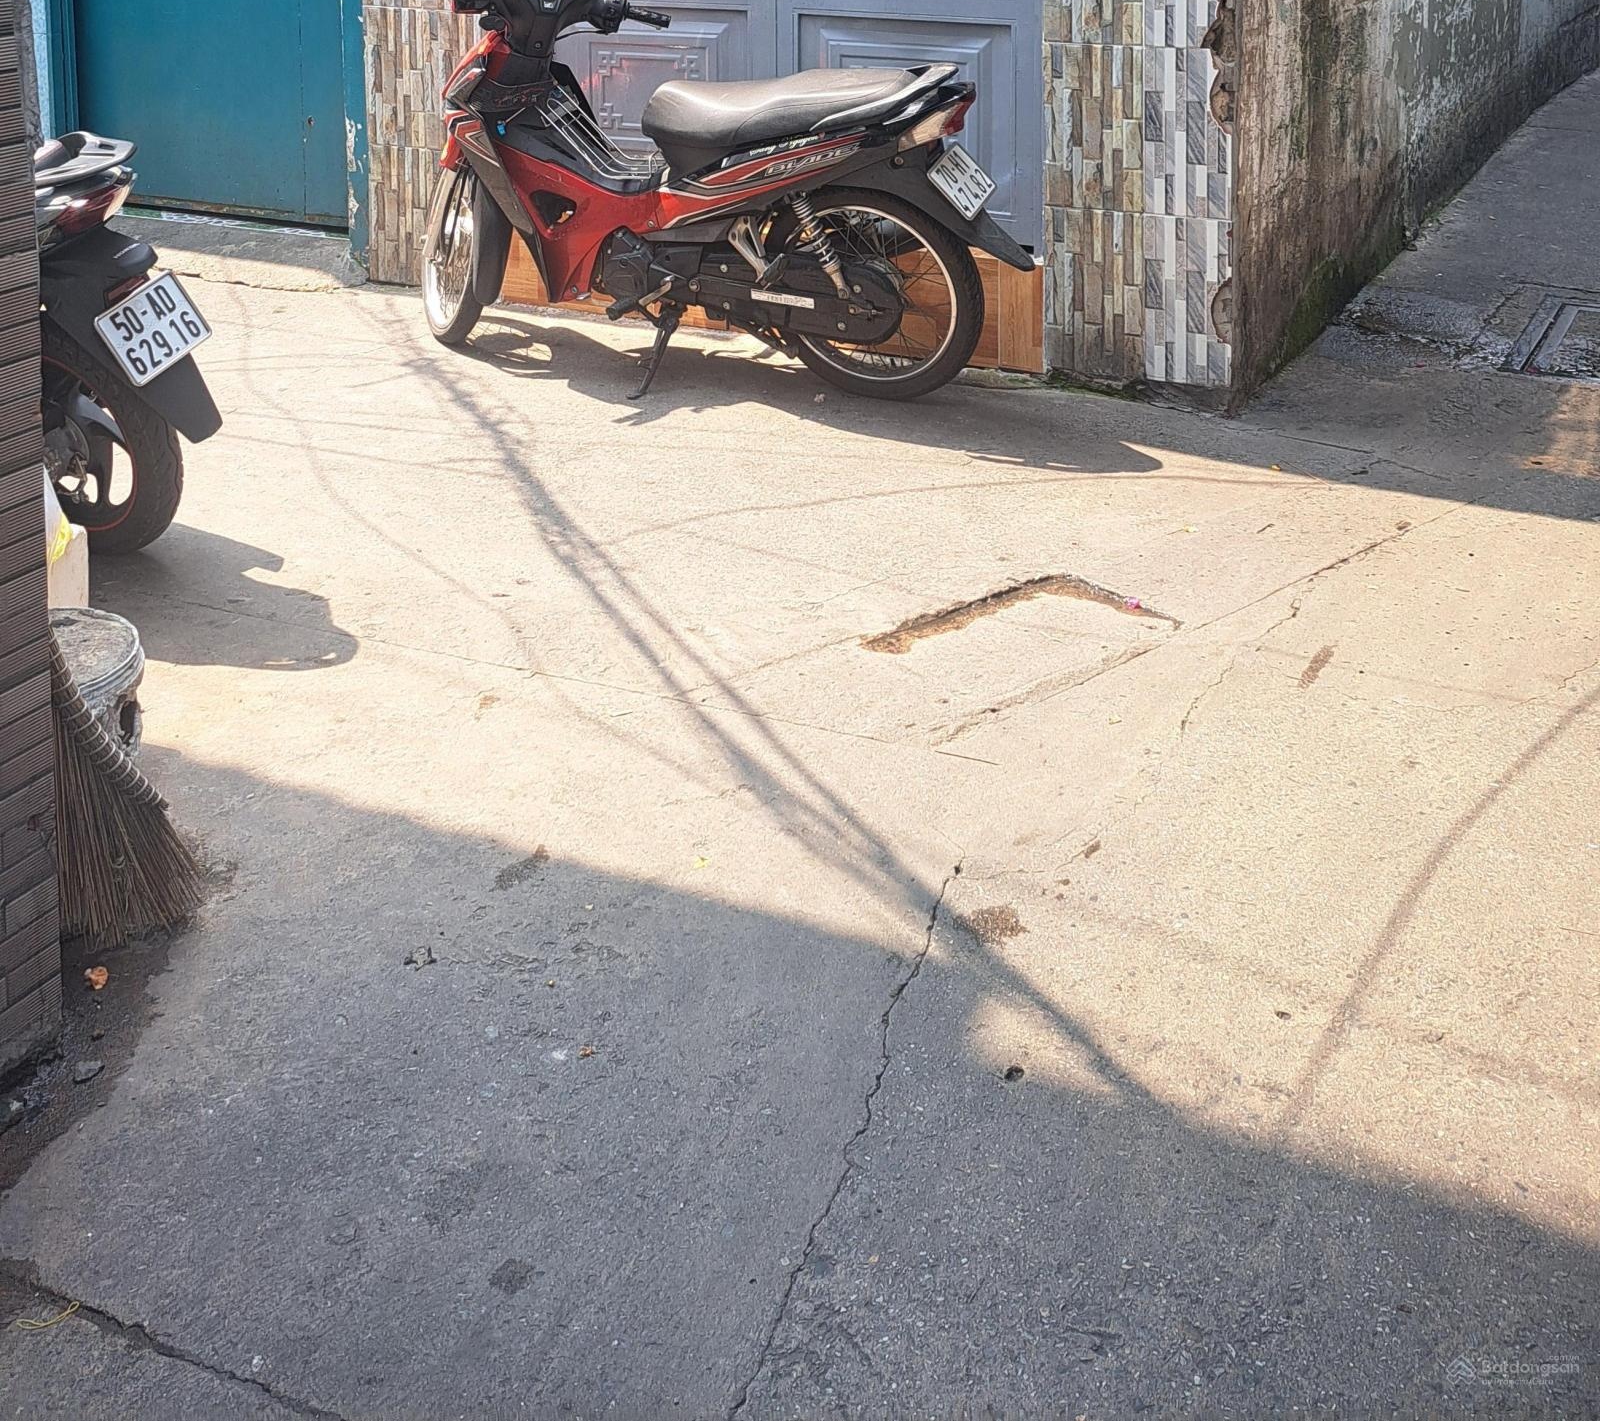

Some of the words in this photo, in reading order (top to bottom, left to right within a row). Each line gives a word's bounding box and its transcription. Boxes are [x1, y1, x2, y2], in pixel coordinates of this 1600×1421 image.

[764, 142, 861, 179] BLADE
[109, 285, 177, 342] 50-AD
[126, 311, 201, 375] 629.16
